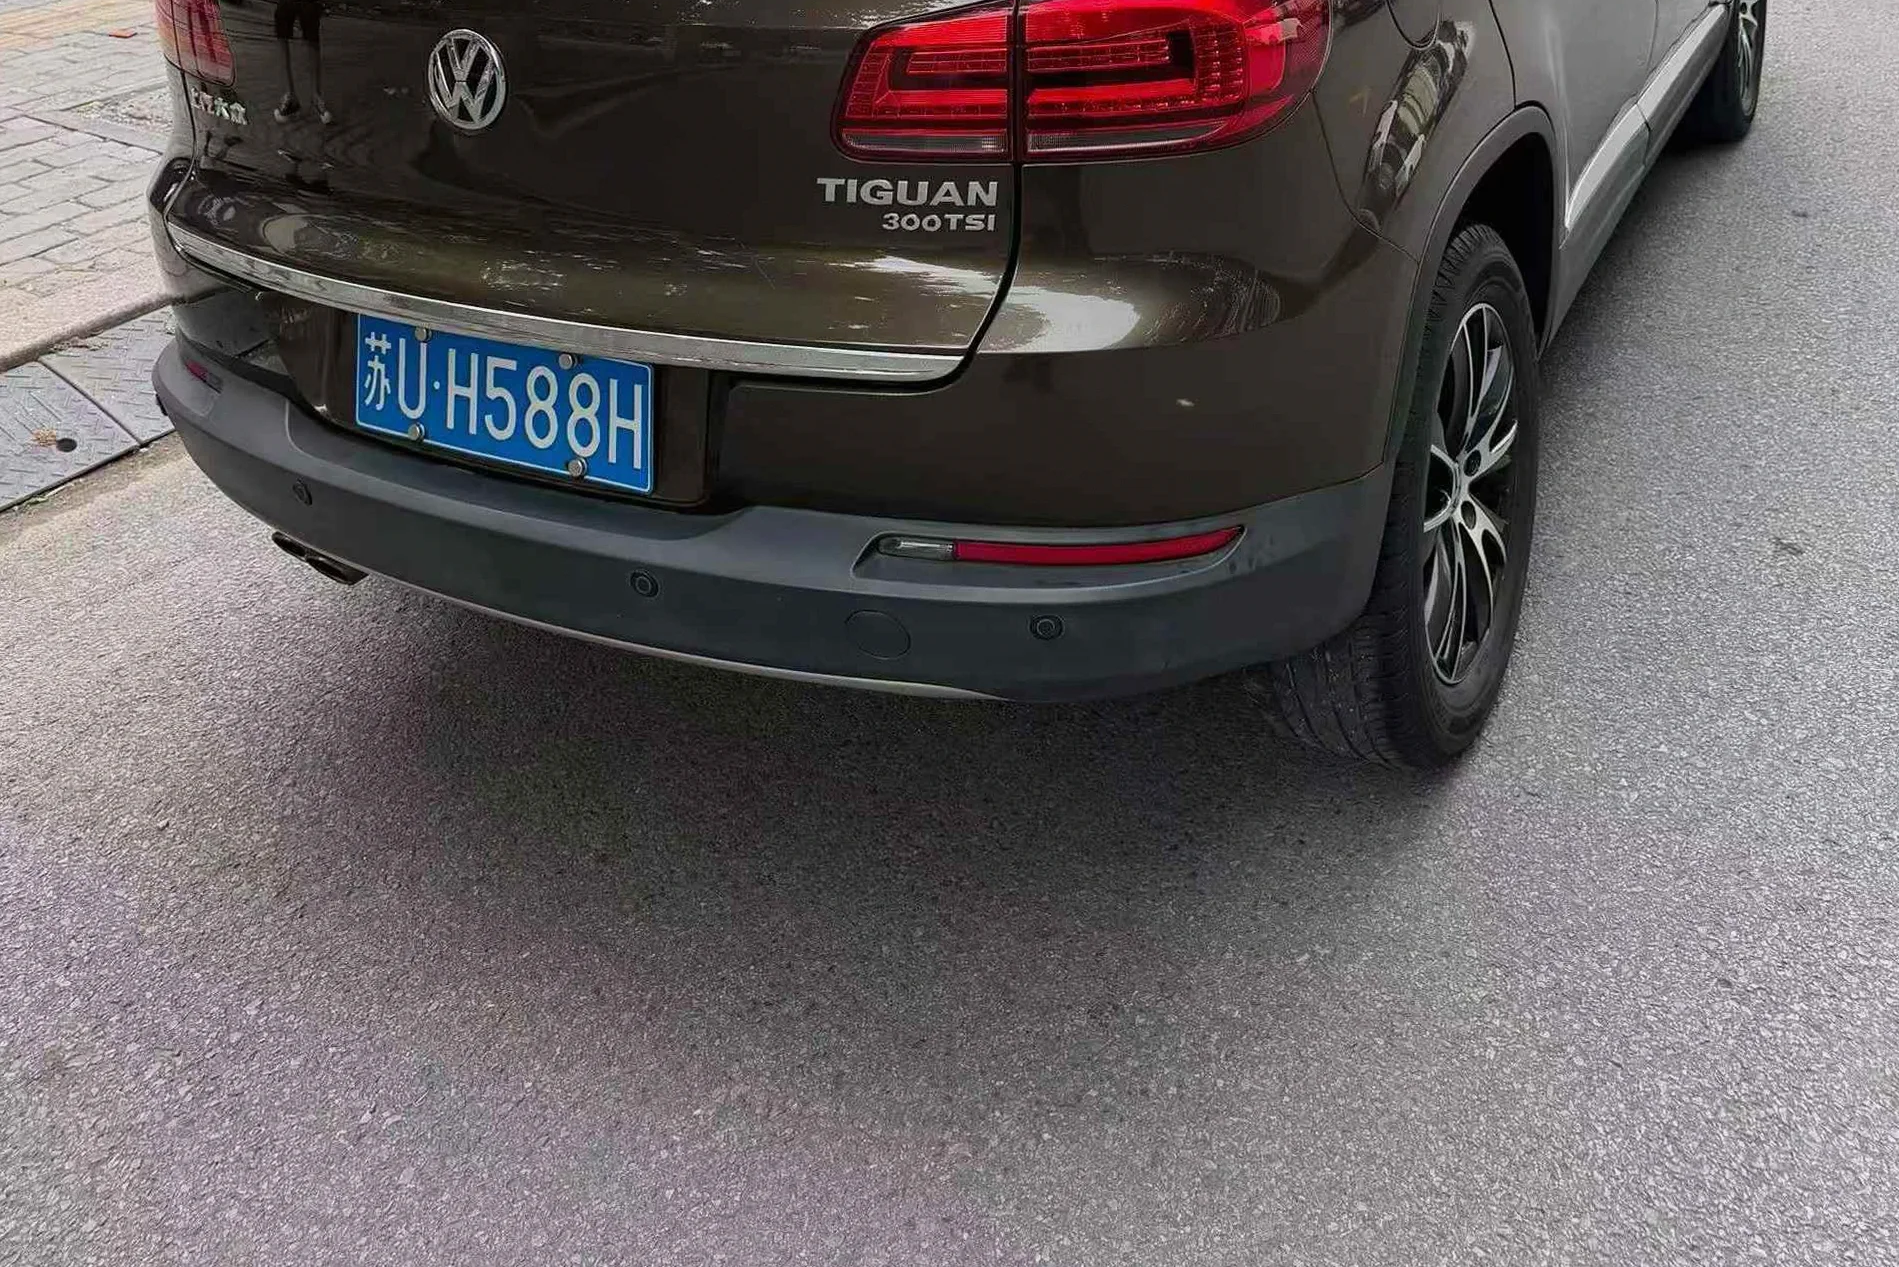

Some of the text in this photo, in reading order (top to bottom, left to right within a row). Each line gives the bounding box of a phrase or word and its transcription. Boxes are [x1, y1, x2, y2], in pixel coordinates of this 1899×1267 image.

[816, 177, 999, 207] TIGUAN
[882, 212, 996, 232] 300TSI
[363, 332, 642, 469] 苏U·H588H
